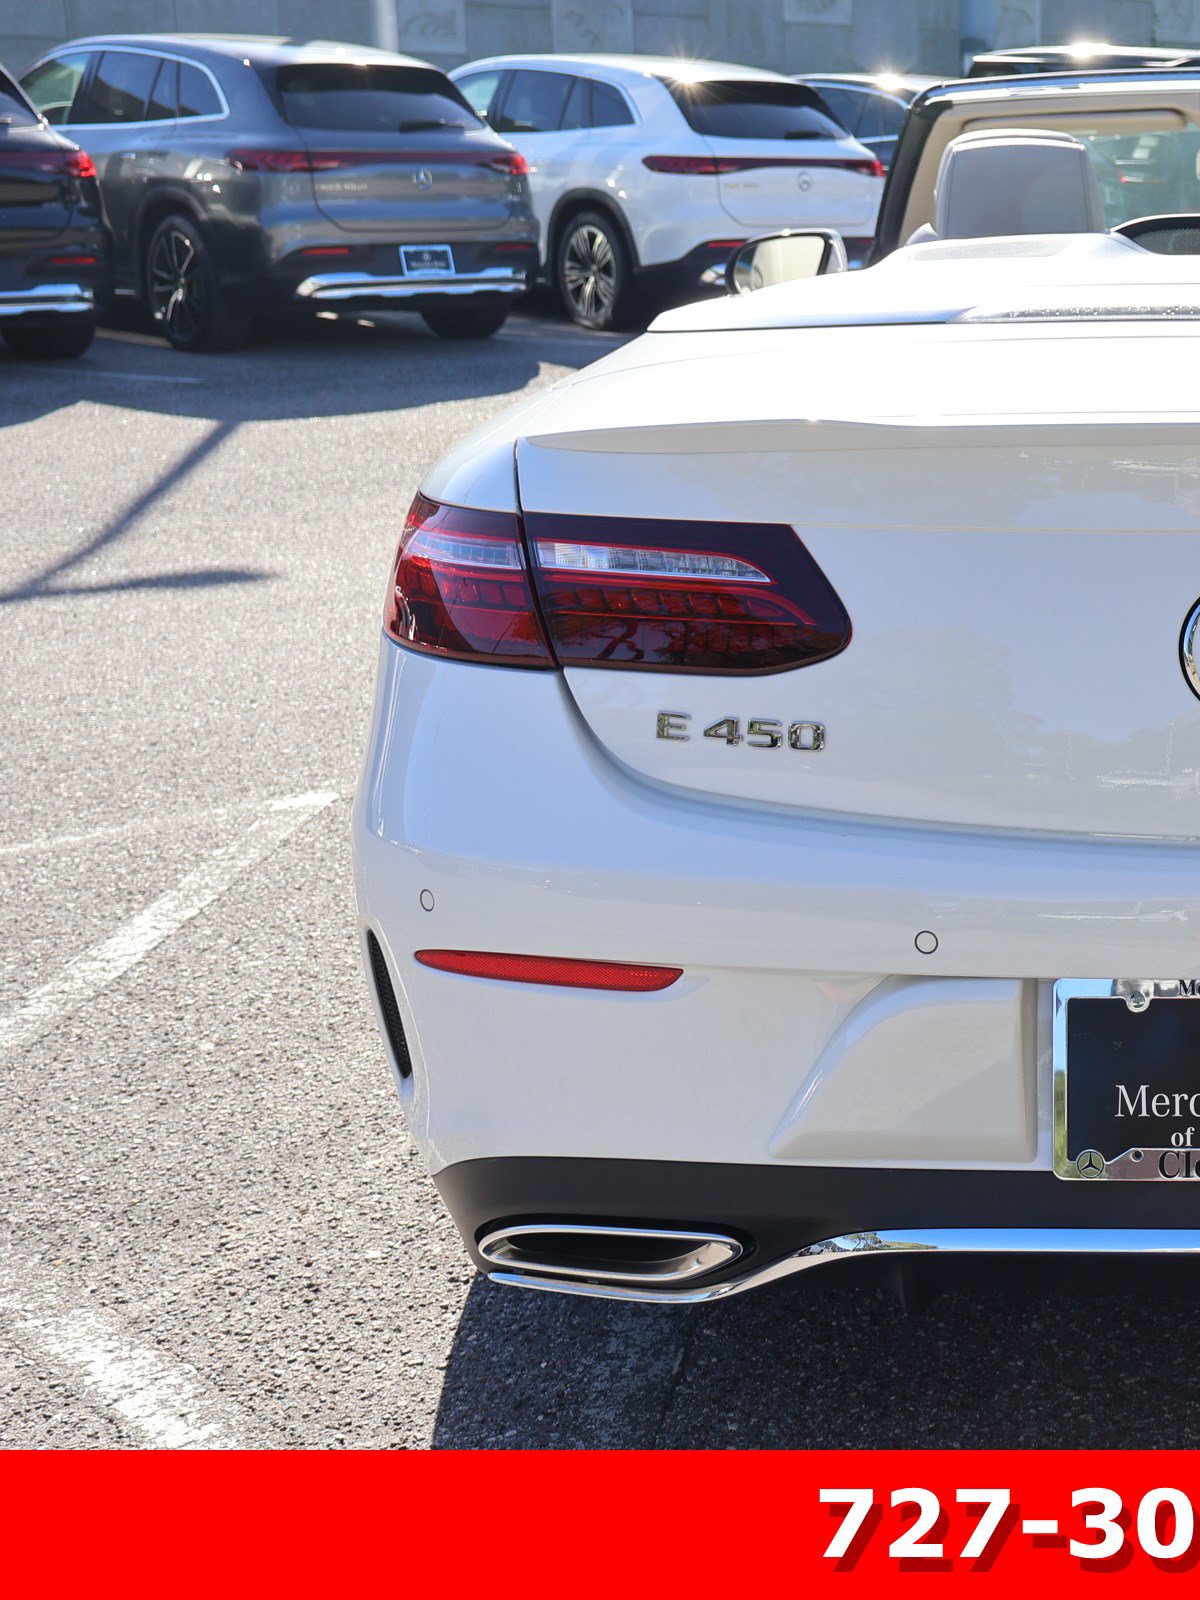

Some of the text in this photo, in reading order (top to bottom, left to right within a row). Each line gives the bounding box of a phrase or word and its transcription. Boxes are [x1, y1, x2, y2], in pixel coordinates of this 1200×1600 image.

[656, 710, 826, 751] E 450
[1170, 1127, 1195, 1147] of
